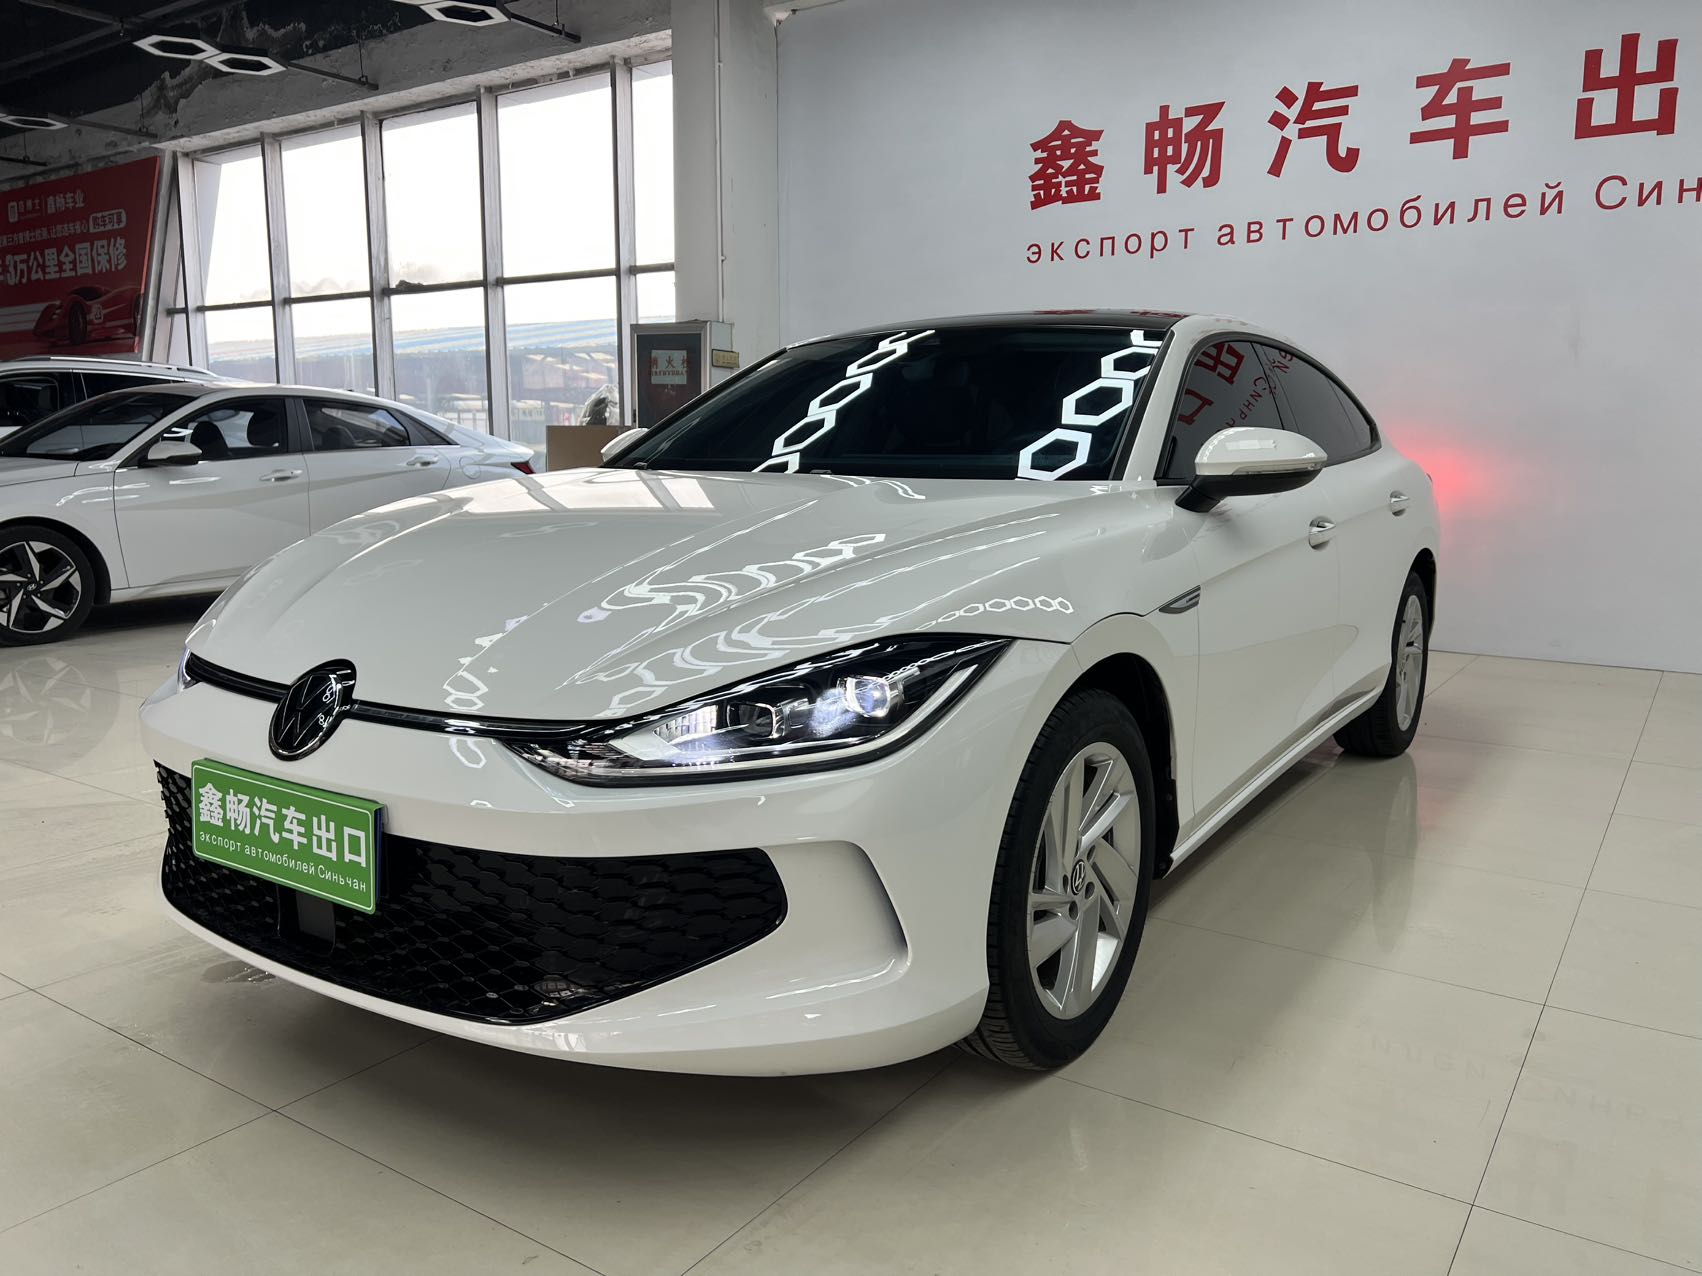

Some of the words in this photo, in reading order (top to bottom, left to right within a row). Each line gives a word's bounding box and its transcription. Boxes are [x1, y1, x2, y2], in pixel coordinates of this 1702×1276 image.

[1029, 33, 1680, 211] 鑫畅汽车出
[1027, 227, 1195, 265] экспорт
[1216, 183, 1564, 247] автомобилей
[198, 782, 367, 868] 鑫畅汽车出口
[199, 831, 242, 854] экспорт
[244, 844, 315, 876] автомобилей
[318, 864, 366, 893] Синьчан
